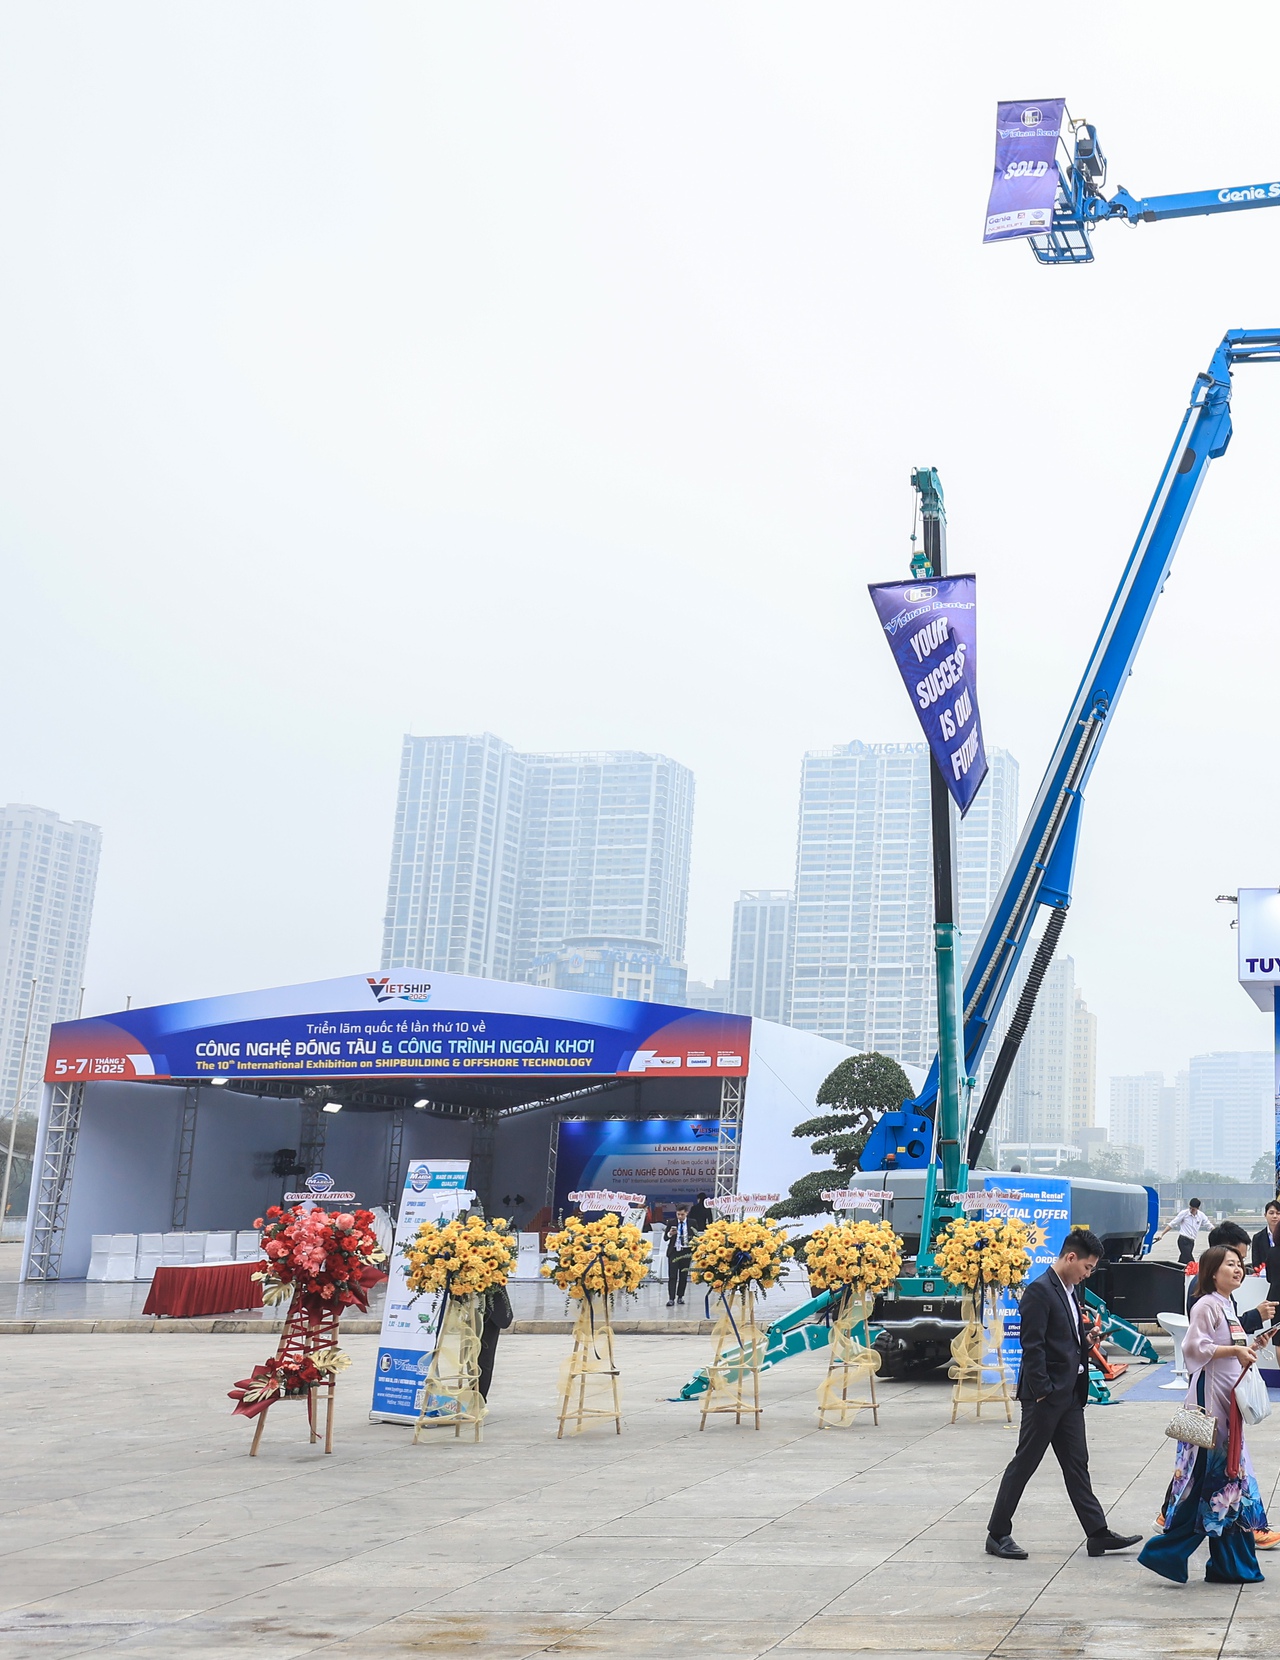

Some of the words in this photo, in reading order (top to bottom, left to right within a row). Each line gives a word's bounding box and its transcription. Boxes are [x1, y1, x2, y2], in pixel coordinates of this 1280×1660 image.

[1004, 161, 1049, 180] SOLD
[1217, 187, 1267, 203] Genie
[883, 606, 931, 636] Vietnam
[909, 616, 949, 663] YOUR
[938, 708, 956, 742] IS
[366, 977, 431, 998] VIETSHIP
[306, 1020, 337, 1034] Triển
[339, 1022, 362, 1034] lãm
[364, 1019, 394, 1036] quốc
[396, 1019, 408, 1032] tế
[411, 1019, 429, 1032] lần
[432, 1021, 454, 1032] thứ
[455, 1022, 469, 1032] 10
[471, 1019, 486, 1032] về
[195, 1040, 240, 1057] CÔNG
[246, 1039, 291, 1059] NGHỆ
[296, 1038, 341, 1056] ĐÓNG
[346, 1038, 376, 1055] TÀU
[382, 1040, 393, 1054] &
[398, 1037, 442, 1054] CÔNG
[448, 1037, 496, 1054] TRÌNH
[500, 1037, 549, 1054] NGOÀI
[555, 1038, 595, 1054] KHƠI
[54, 1059, 88, 1075] 5-7
[94, 1064, 125, 1074] 2025
[195, 1061, 215, 1070] The
[237, 1060, 304, 1070] International
[306, 1060, 357, 1069] Exhibition
[360, 1061, 372, 1069] on
[375, 1058, 450, 1068] SHIPBUILDING
[452, 1058, 461, 1068] &
[463, 1058, 519, 1068] OFFSHORE
[522, 1058, 593, 1068] TECHNOLOGY
[612, 1168, 632, 1176] CÔNG
[635, 1168, 656, 1177] NGHỆ
[658, 1167, 679, 1176] ĐÓNG
[682, 1167, 696, 1176] TÀU
[286, 1192, 354, 1200] CONGRATULATIONS
[1041, 1191, 1064, 1199] Rental
[985, 1208, 1031, 1219] SPECIAL
[1033, 1208, 1069, 1220] OFFER
[1035, 1256, 1059, 1264] ORDE
[999, 1308, 1017, 1316] NEW
